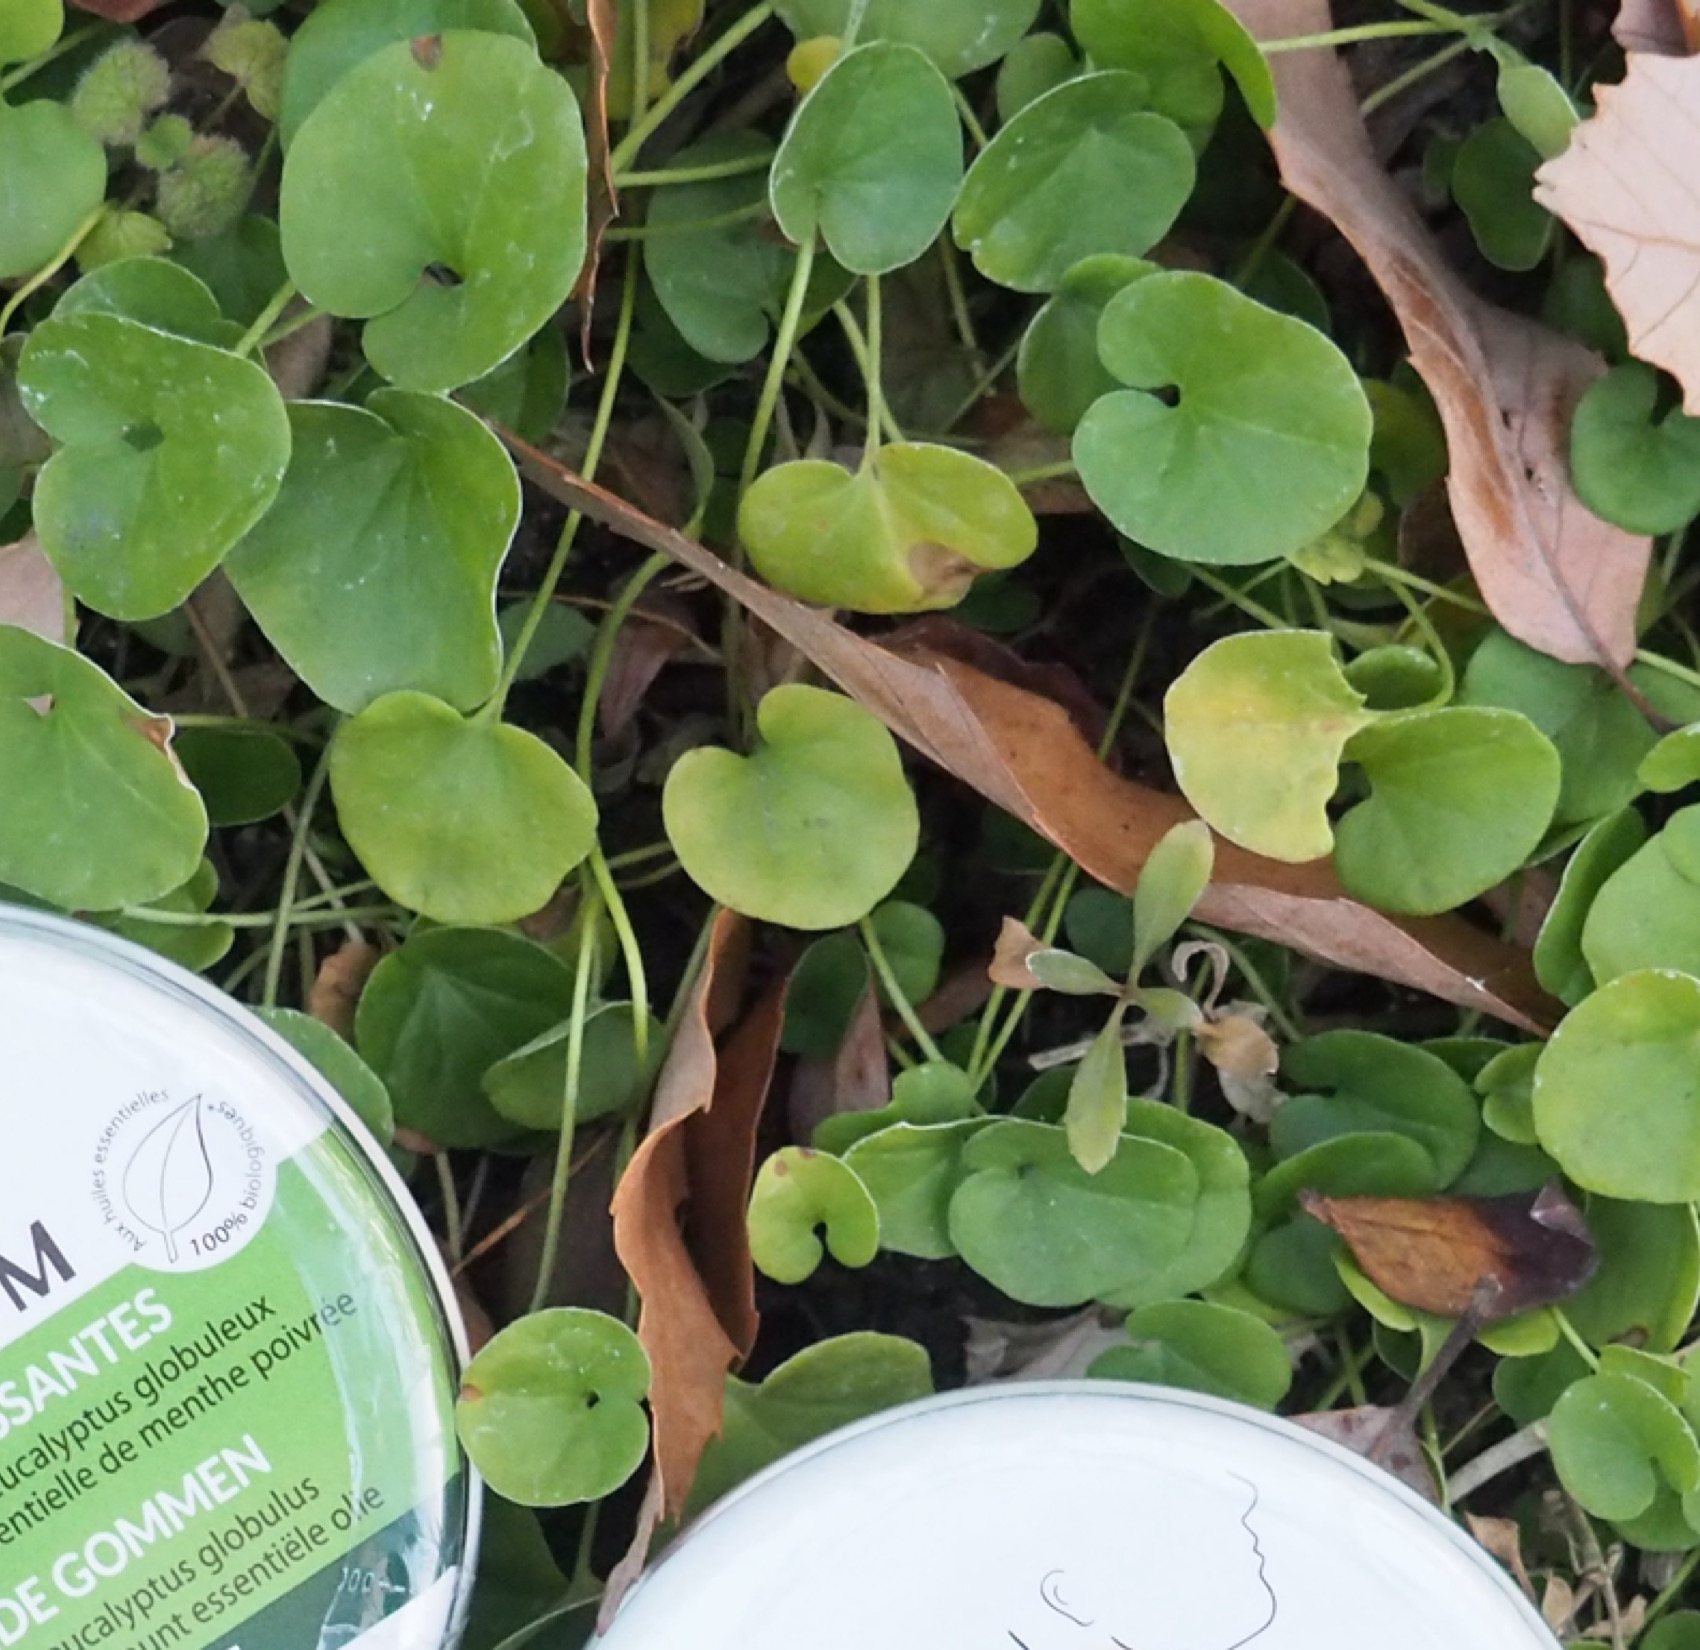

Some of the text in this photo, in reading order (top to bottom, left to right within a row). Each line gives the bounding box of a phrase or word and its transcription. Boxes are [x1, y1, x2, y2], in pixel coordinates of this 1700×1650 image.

[90, 1089, 170, 1252] Aux huiles essentielles
[189, 1212, 249, 1256] 100%
[98, 1437, 139, 1476] de
[138, 1367, 250, 1447] menthe
[251, 1290, 359, 1377] poivrée
[133, 1295, 278, 1404] globuleux
[52, 1434, 272, 1597] GOMMEN
[199, 1475, 320, 1574] globulus
[193, 1527, 330, 1624] essentiële
